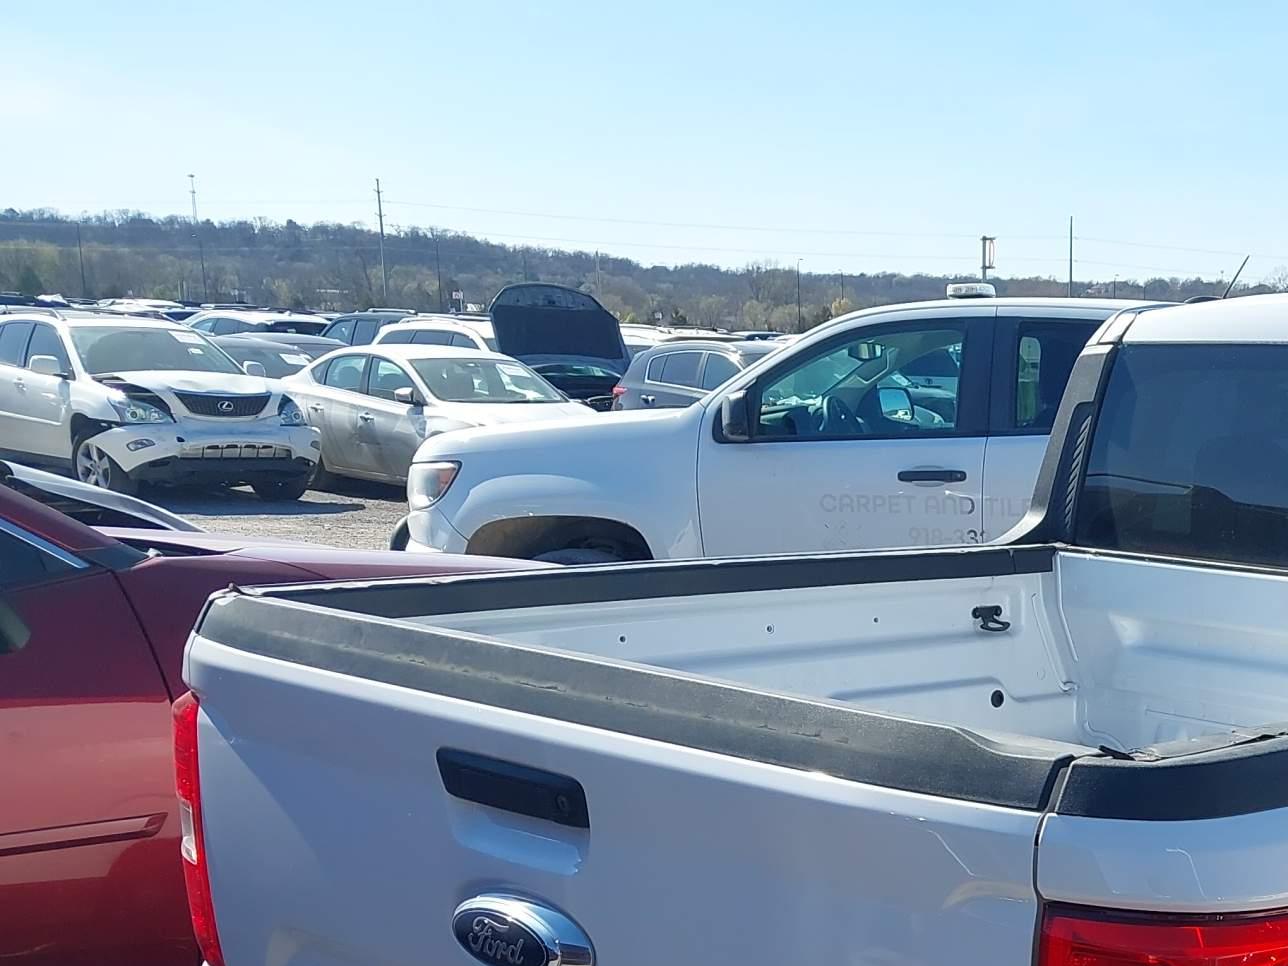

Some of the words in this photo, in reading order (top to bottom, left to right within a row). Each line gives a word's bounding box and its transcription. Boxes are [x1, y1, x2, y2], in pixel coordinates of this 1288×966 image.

[820, 494, 914, 515] CARPET
[924, 495, 976, 516] AND
[467, 915, 525, 965] Ford
